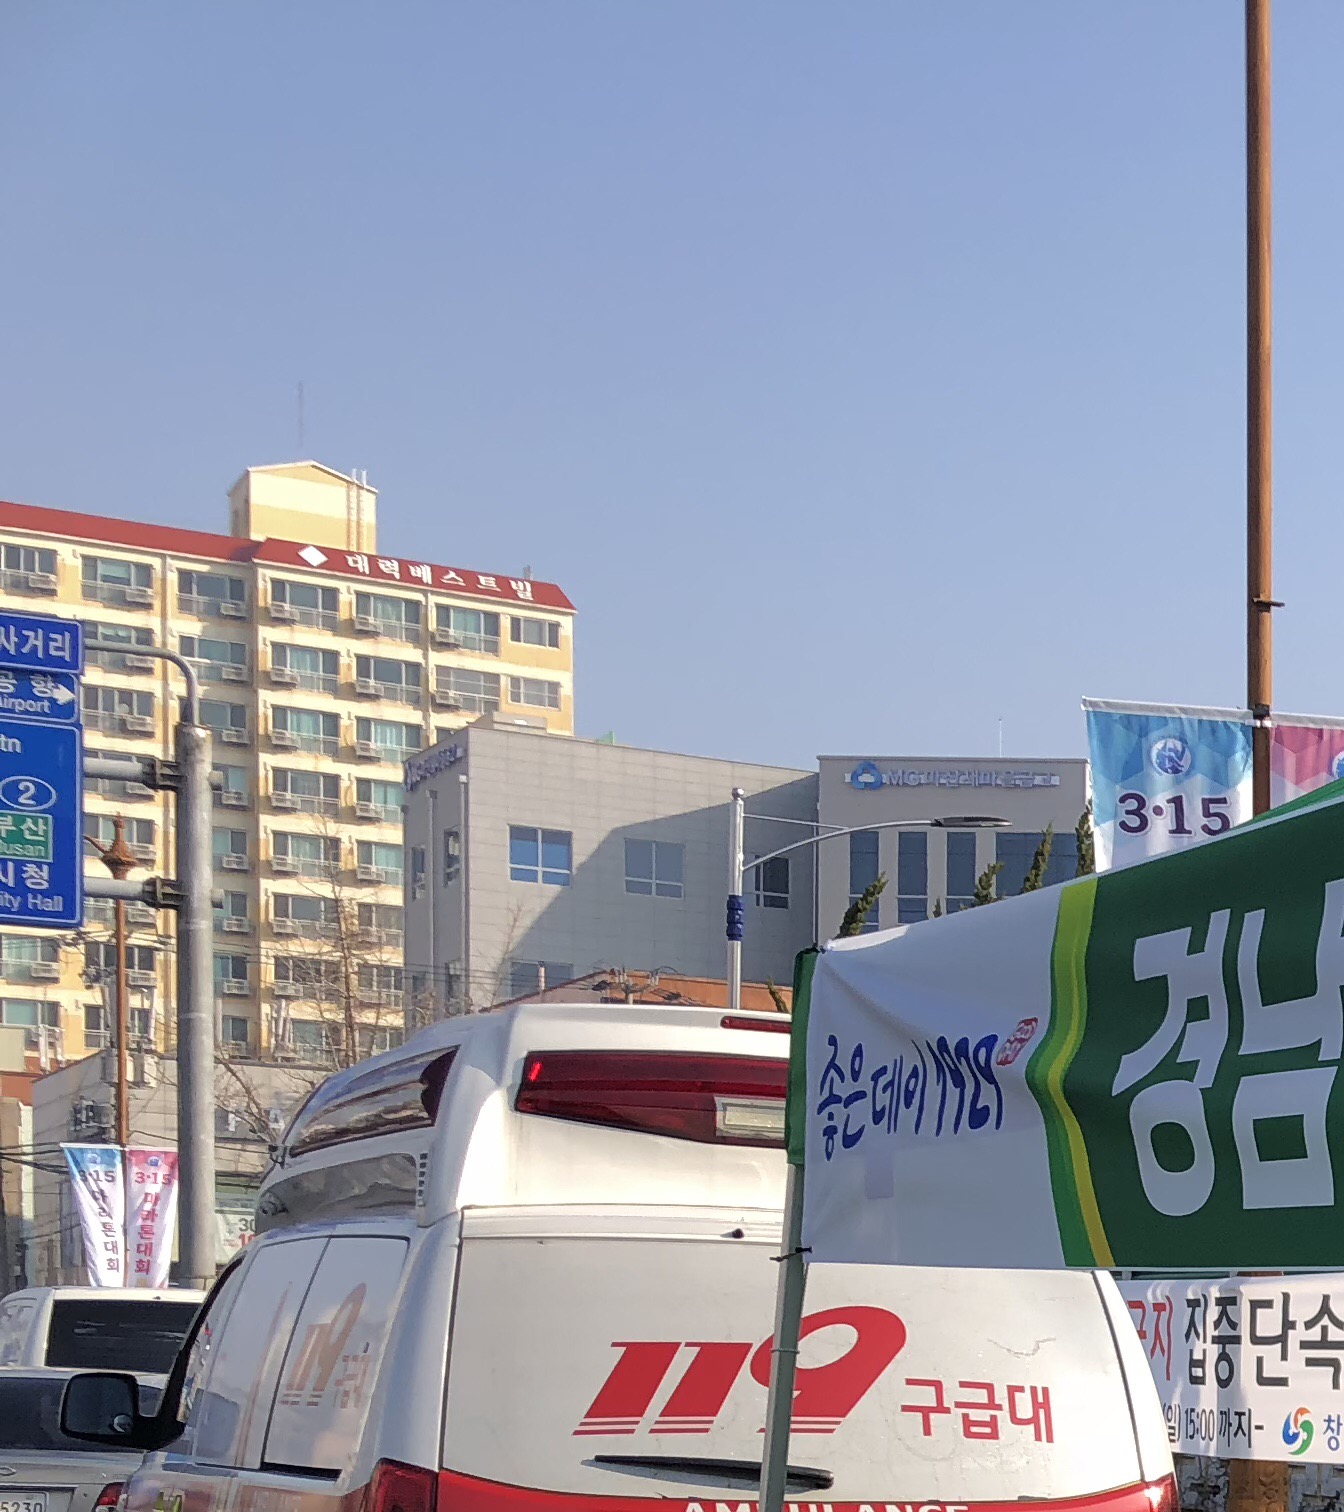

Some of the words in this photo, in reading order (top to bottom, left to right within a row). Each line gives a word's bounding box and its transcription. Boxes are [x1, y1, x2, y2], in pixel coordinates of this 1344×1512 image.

[0, 694, 51, 714] irport
[17, 781, 36, 805] 2
[0, 840, 45, 857] usan
[27, 893, 64, 911] Hall
[572, 1305, 907, 1436] 119
[900, 1377, 1054, 1444] 구급대
[1185, 1406, 1215, 1443] 15:00
